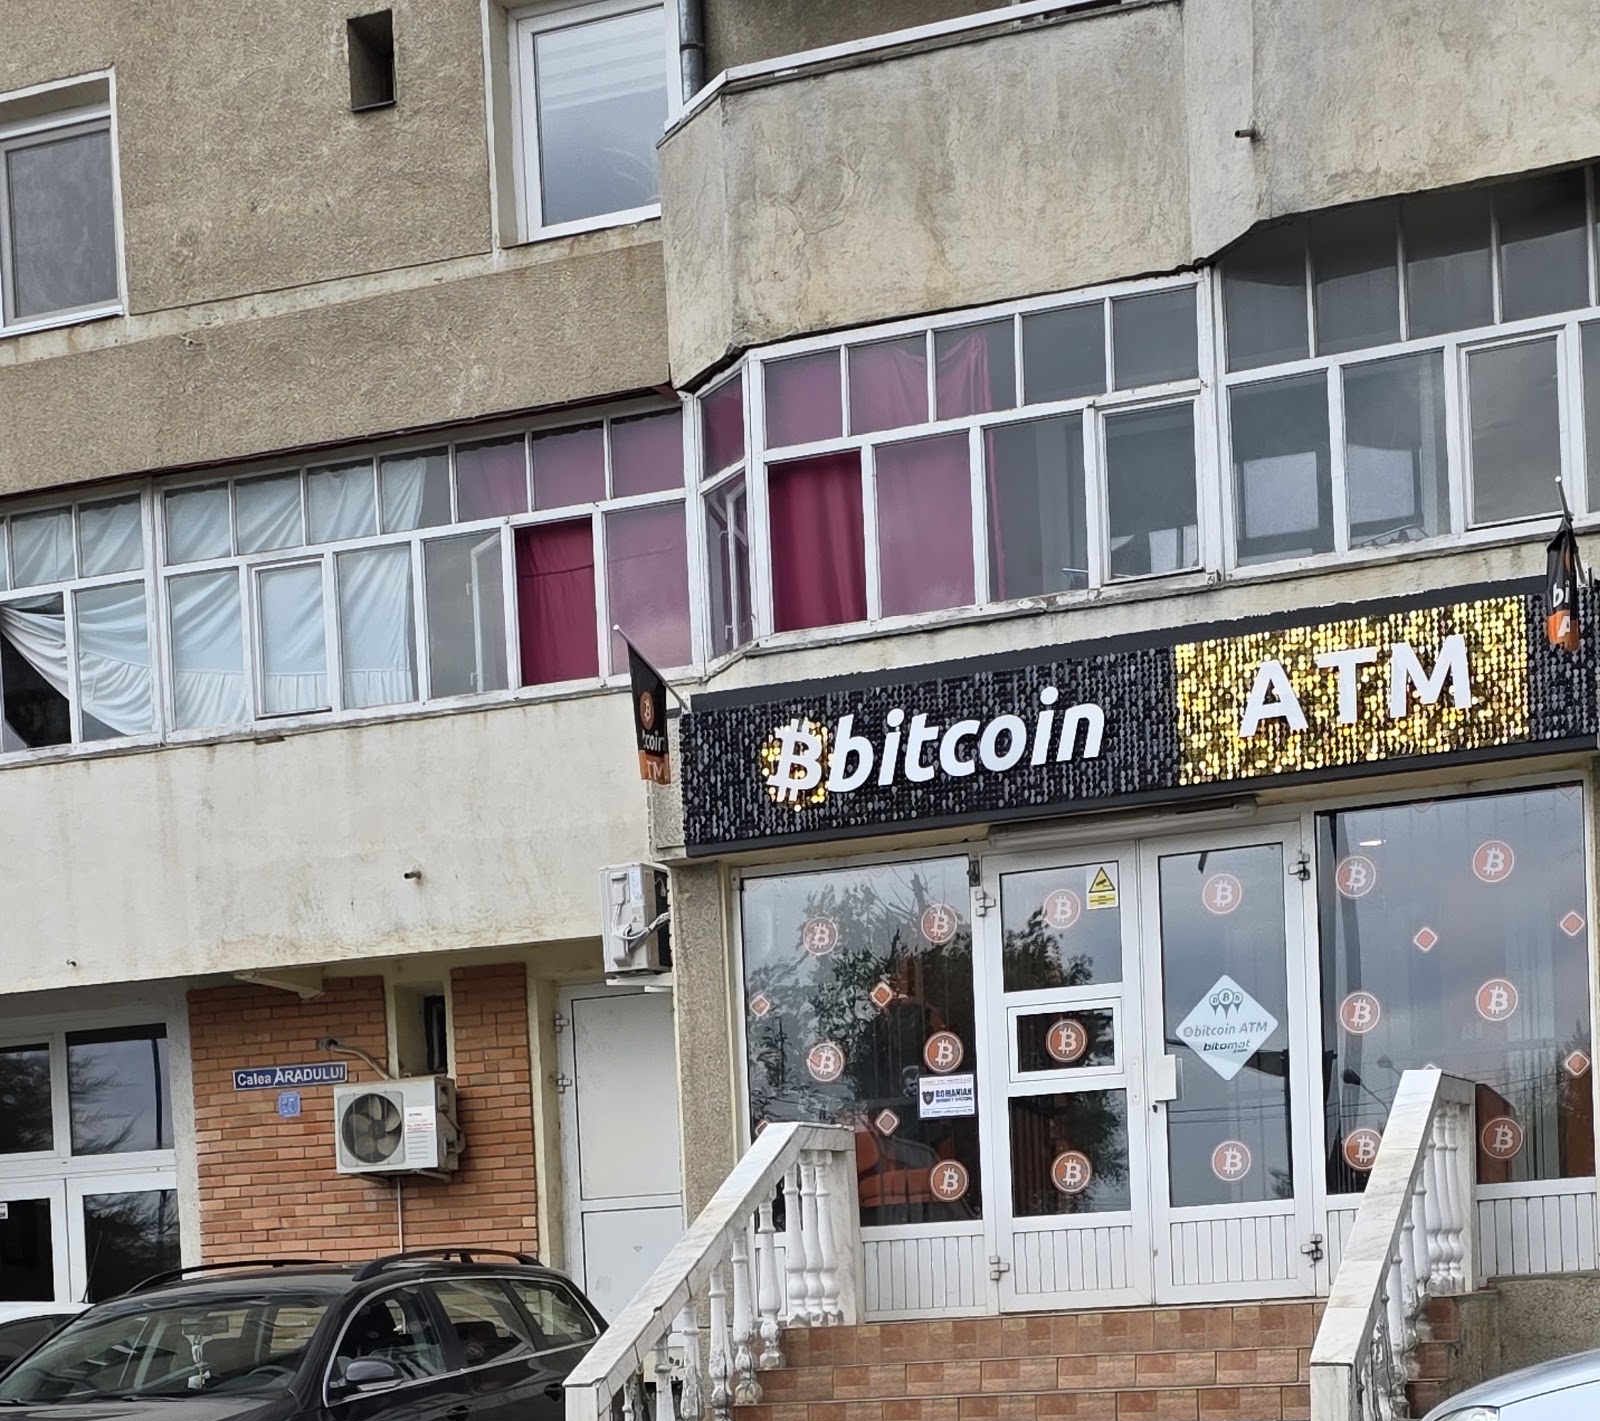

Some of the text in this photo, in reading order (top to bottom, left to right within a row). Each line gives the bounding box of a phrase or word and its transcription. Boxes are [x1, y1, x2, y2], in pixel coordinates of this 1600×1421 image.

[1239, 633, 1472, 738] ATM
[1194, 1021, 1268, 1038] bitcoin ATM
[237, 1066, 344, 1087] Calea ARADULUI
